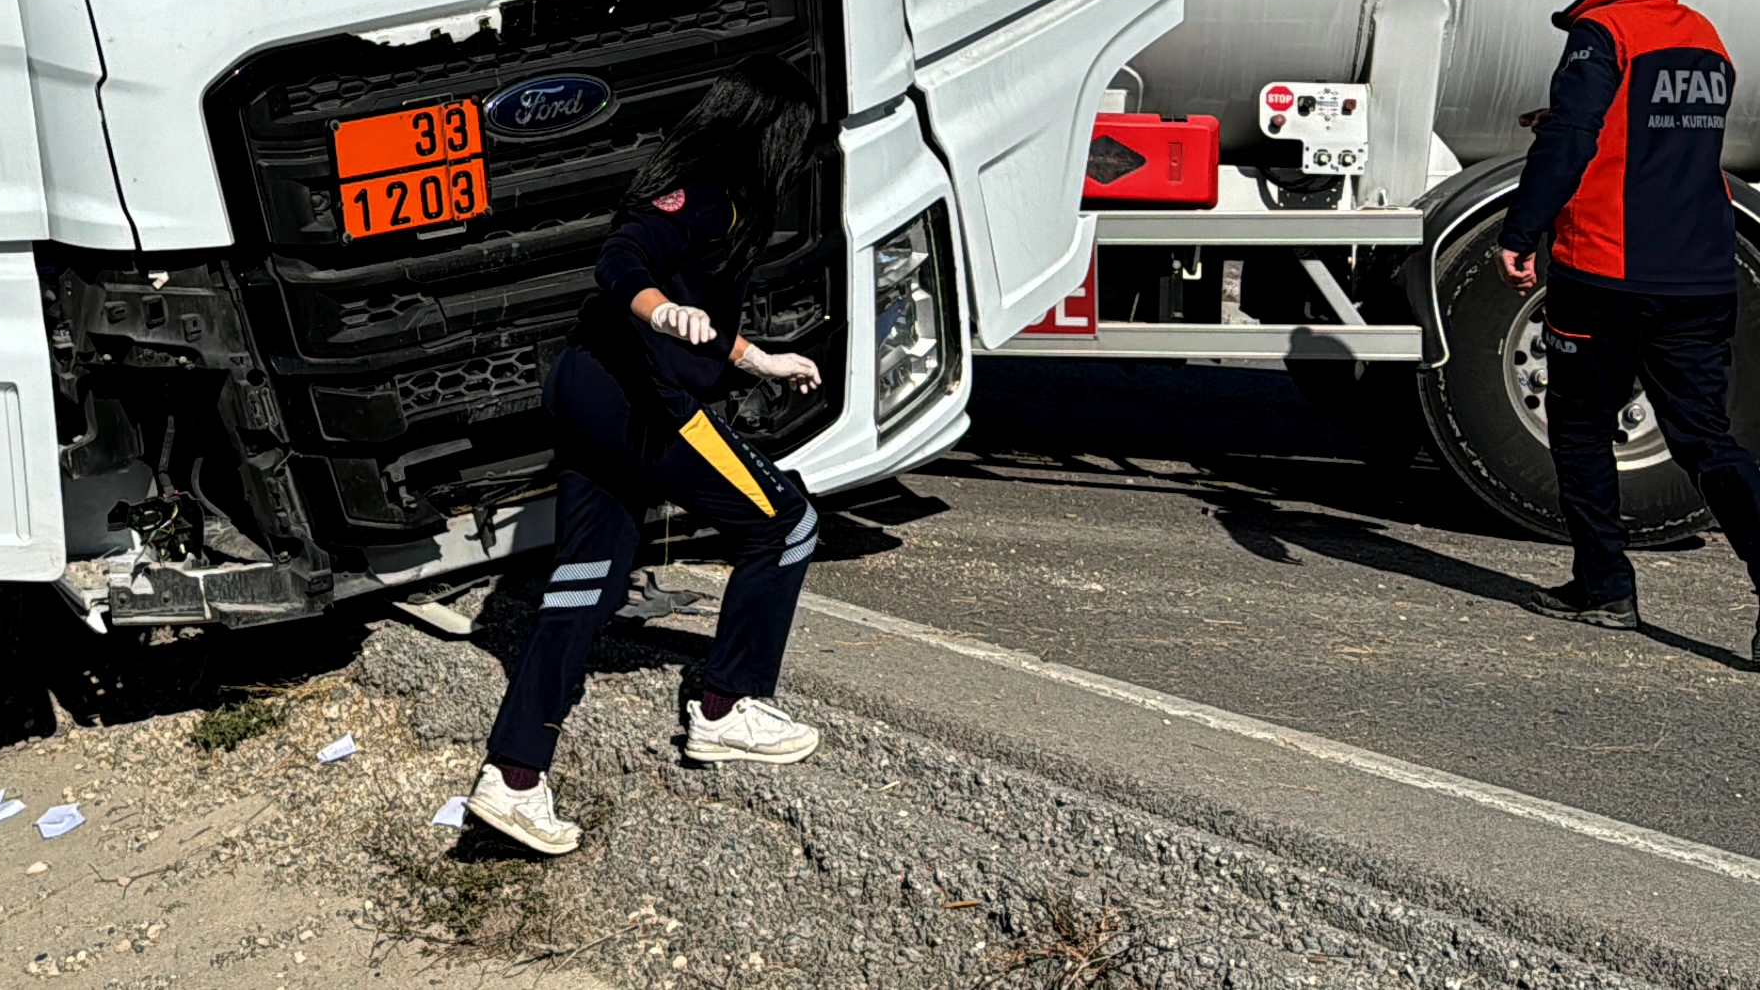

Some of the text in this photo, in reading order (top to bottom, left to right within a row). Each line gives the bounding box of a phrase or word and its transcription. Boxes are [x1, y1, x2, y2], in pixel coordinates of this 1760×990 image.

[515, 84, 585, 126] Ford
[1267, 93, 1293, 105] STOP
[1650, 69, 1728, 105] AFAD
[412, 107, 469, 157] 33
[1647, 114, 1676, 129] ARAMA
[353, 170, 476, 232] 1203
